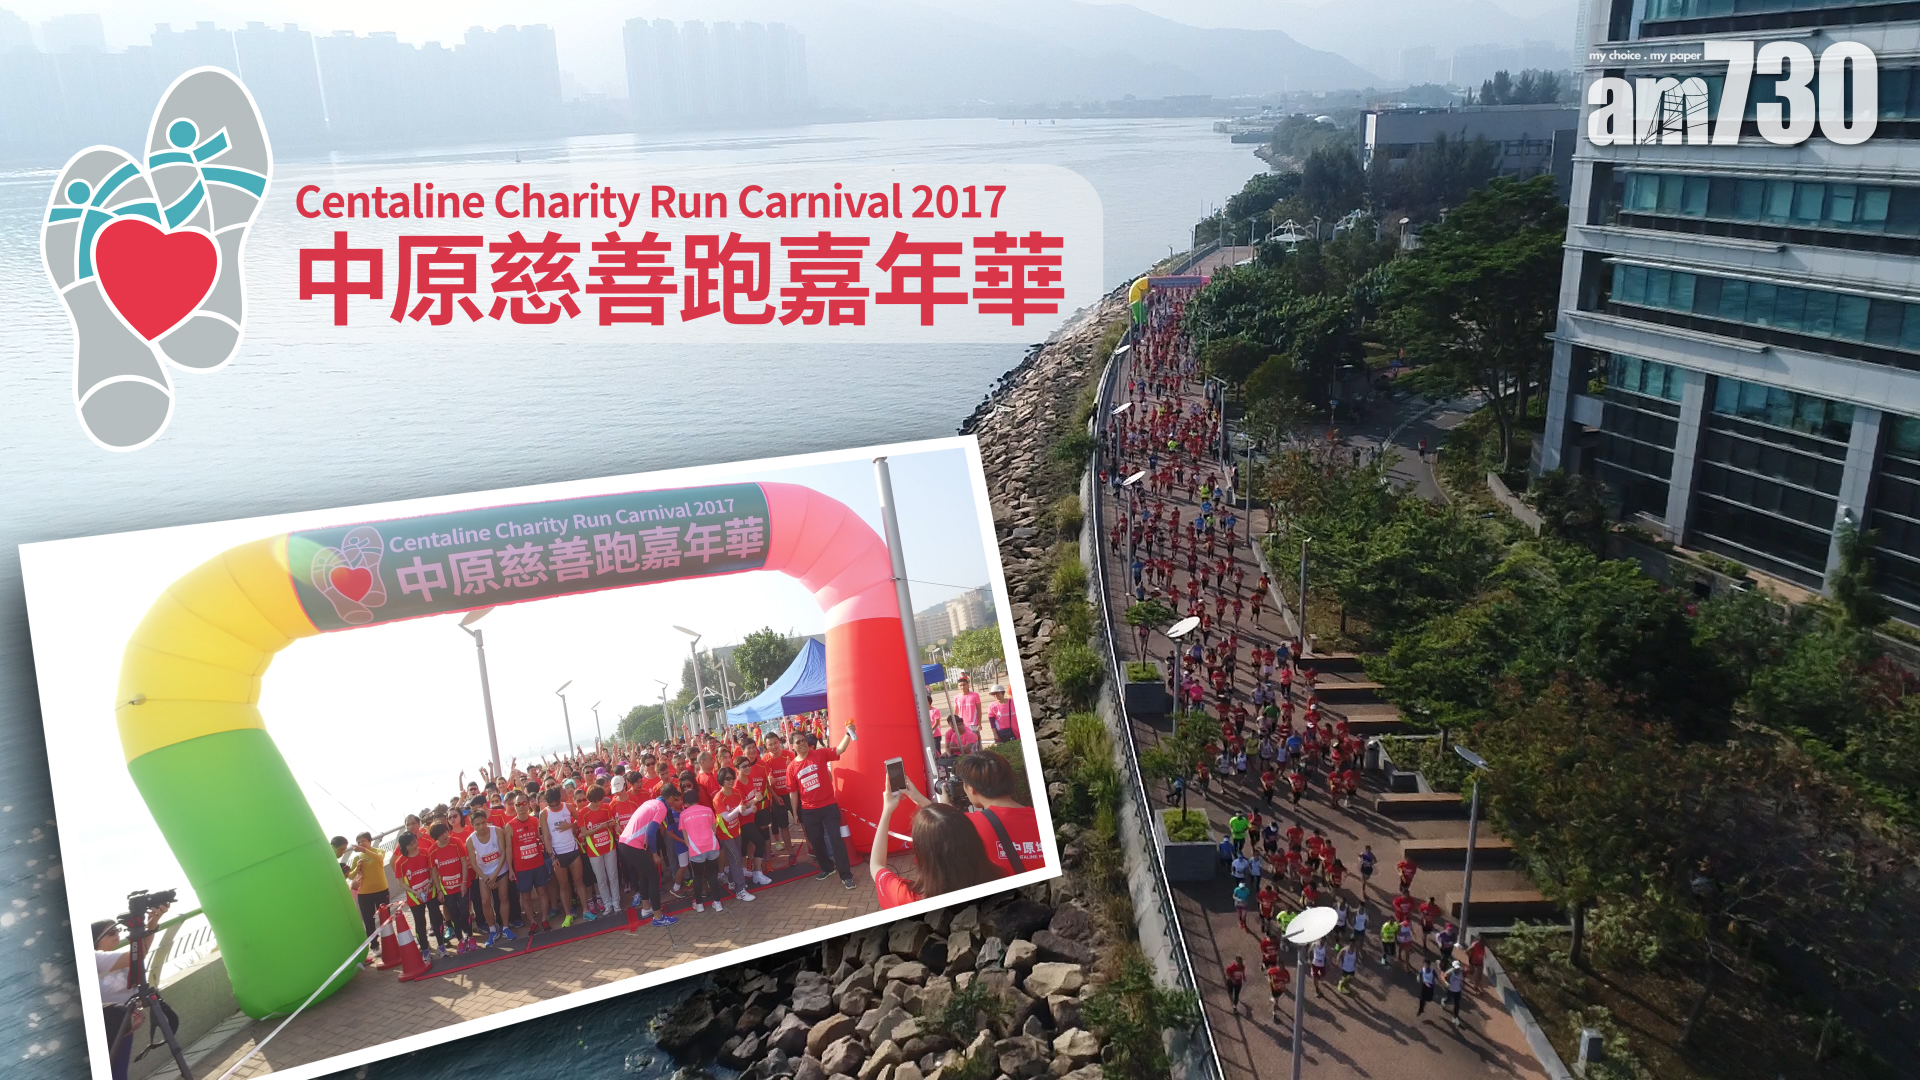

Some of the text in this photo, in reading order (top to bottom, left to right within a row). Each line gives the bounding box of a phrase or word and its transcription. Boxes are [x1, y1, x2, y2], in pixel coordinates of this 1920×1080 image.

[389, 498, 735, 553] Centaline Charity Run Carnival 2017
[396, 515, 764, 602] 中原慈善跑嘉年華
